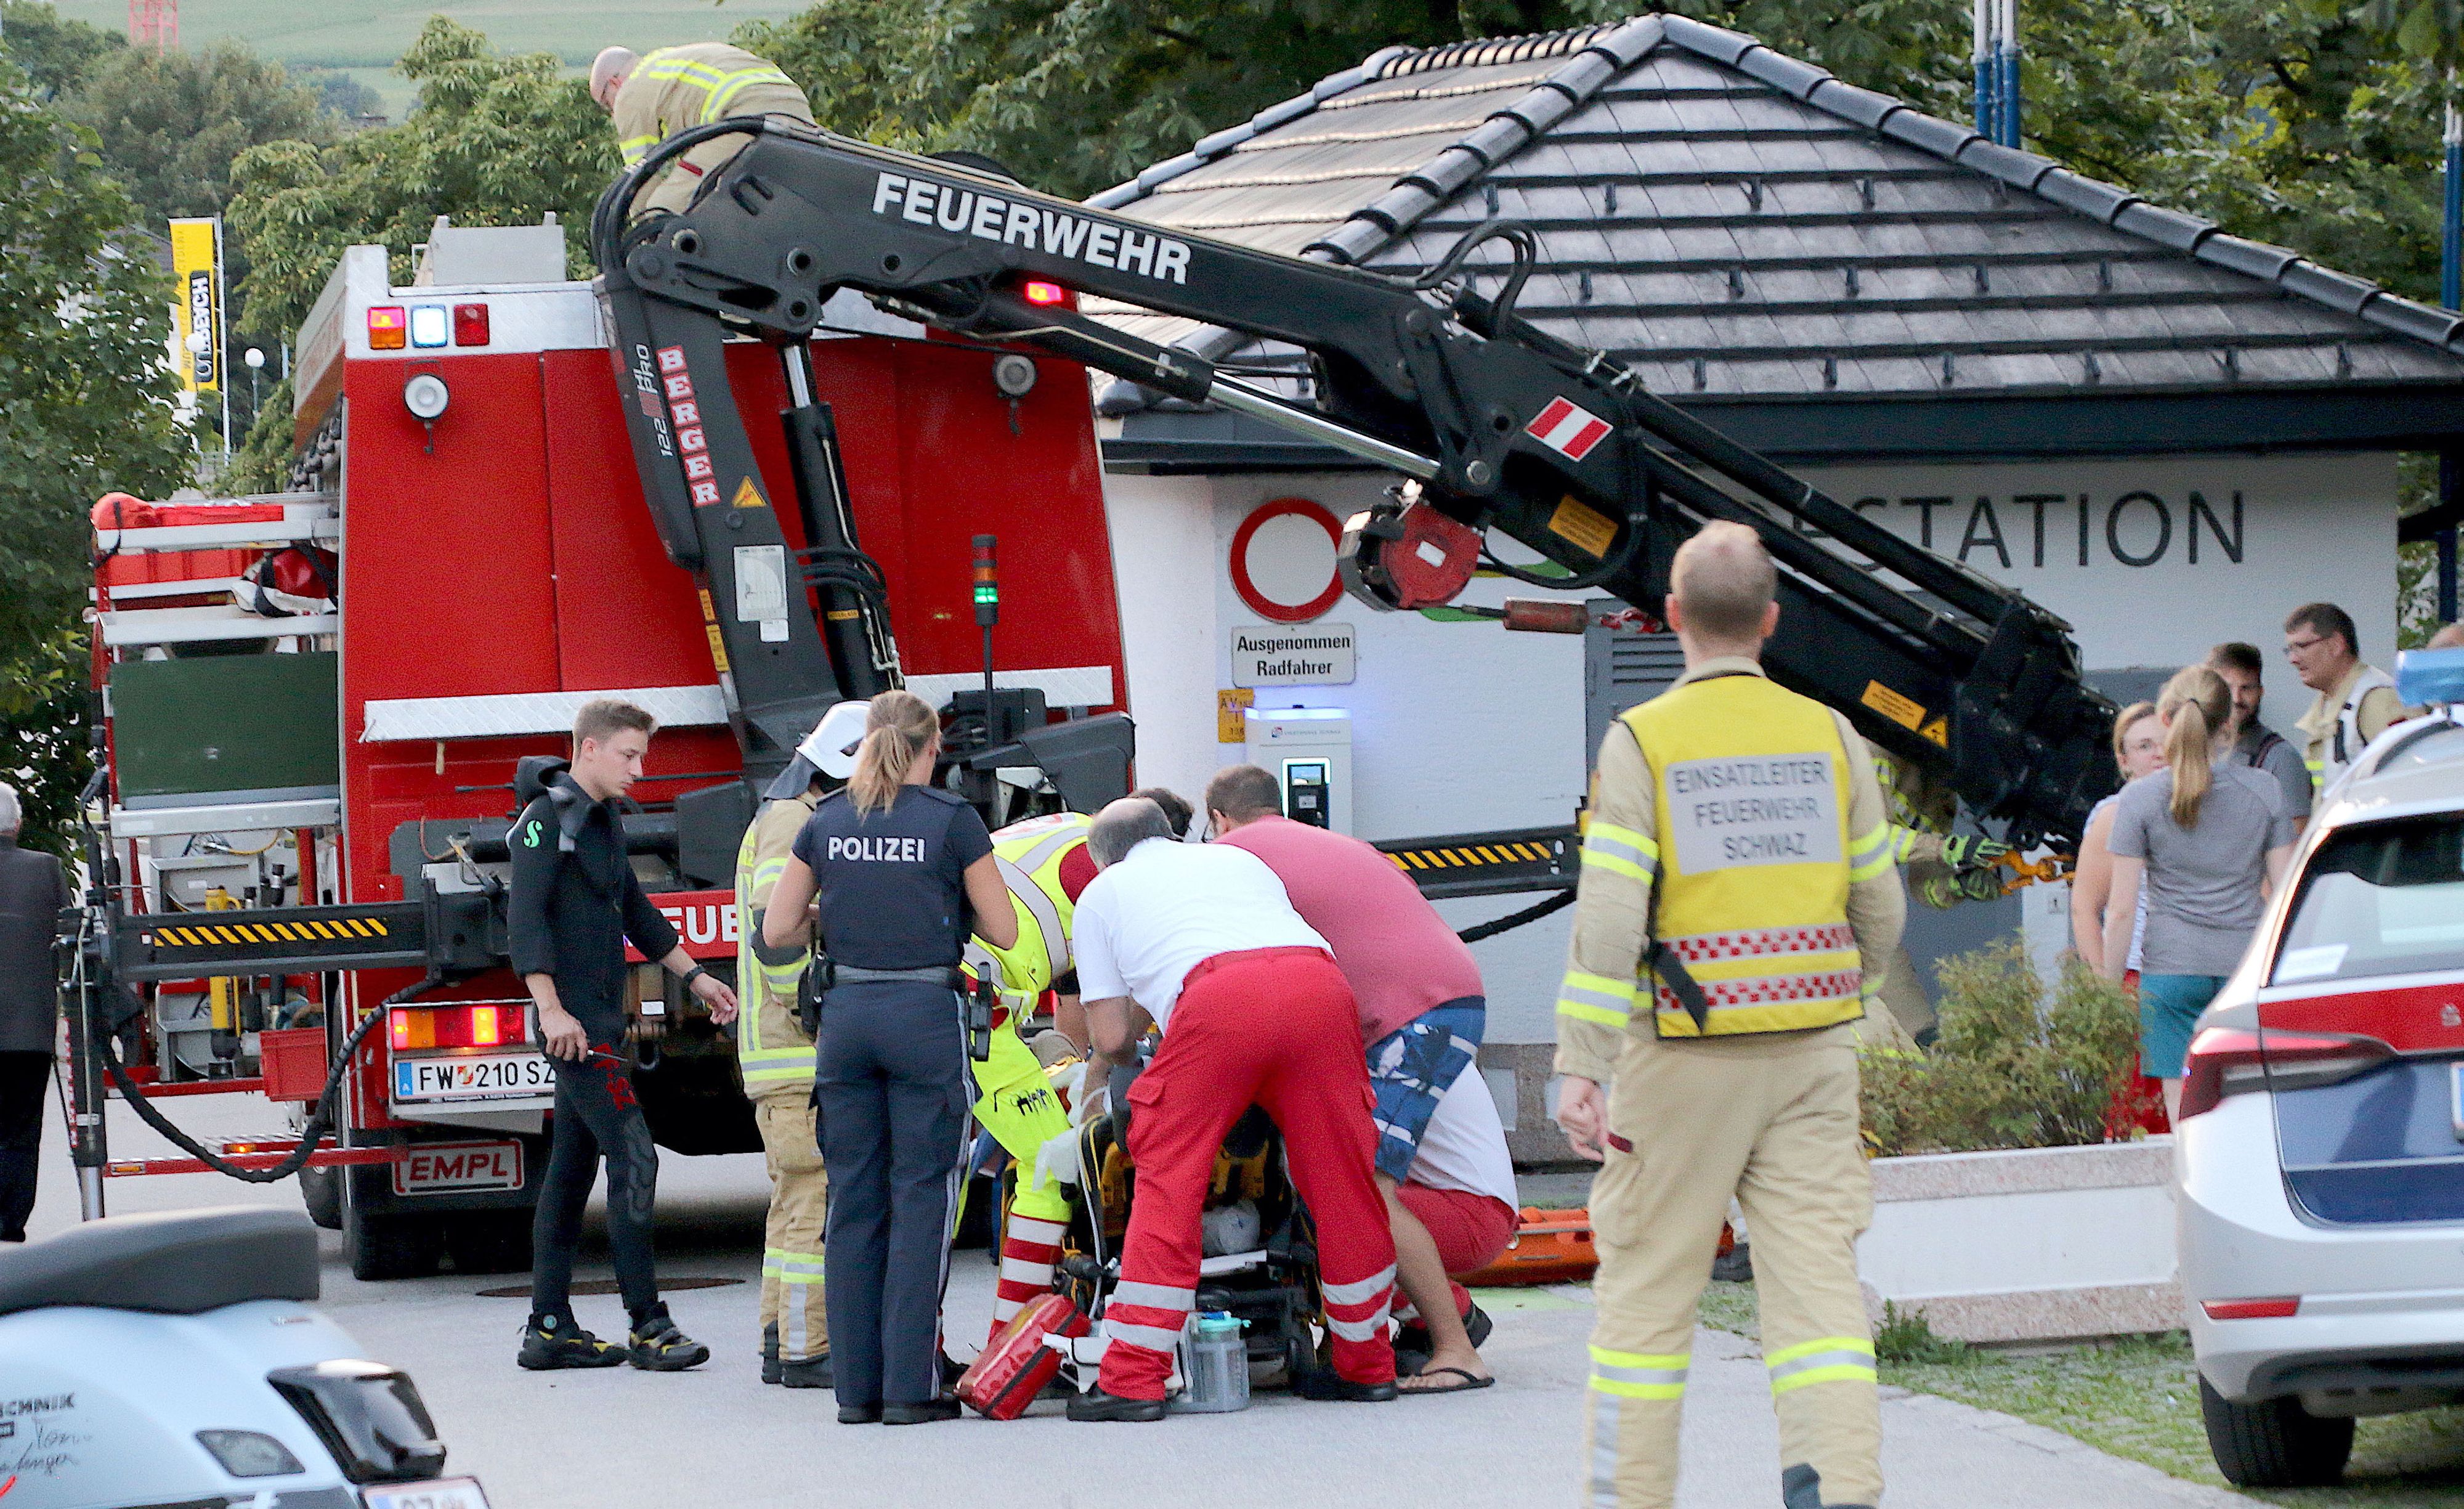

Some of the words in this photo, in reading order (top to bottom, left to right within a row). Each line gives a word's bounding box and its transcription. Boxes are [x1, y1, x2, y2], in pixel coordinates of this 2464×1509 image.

[872, 171, 1191, 285] FEUERWEHR
[653, 417, 674, 457] 122
[657, 348, 718, 504] BERGER
[1237, 635, 1351, 654] Ausgenommen
[1257, 659, 1332, 677] Radfahrer
[1674, 760, 1827, 794] EINSATZLEITER
[1695, 797, 1821, 828] FEUERWEHR
[828, 836, 925, 862] POLIZEI
[1723, 832, 1808, 860] SCHWAZ
[419, 1065, 454, 1090] FW
[476, 1062, 519, 1087] 210
[526, 1060, 556, 1084] SZ
[409, 1153, 508, 1181] EMPL
[0, 1393, 75, 1418] CHNIK
